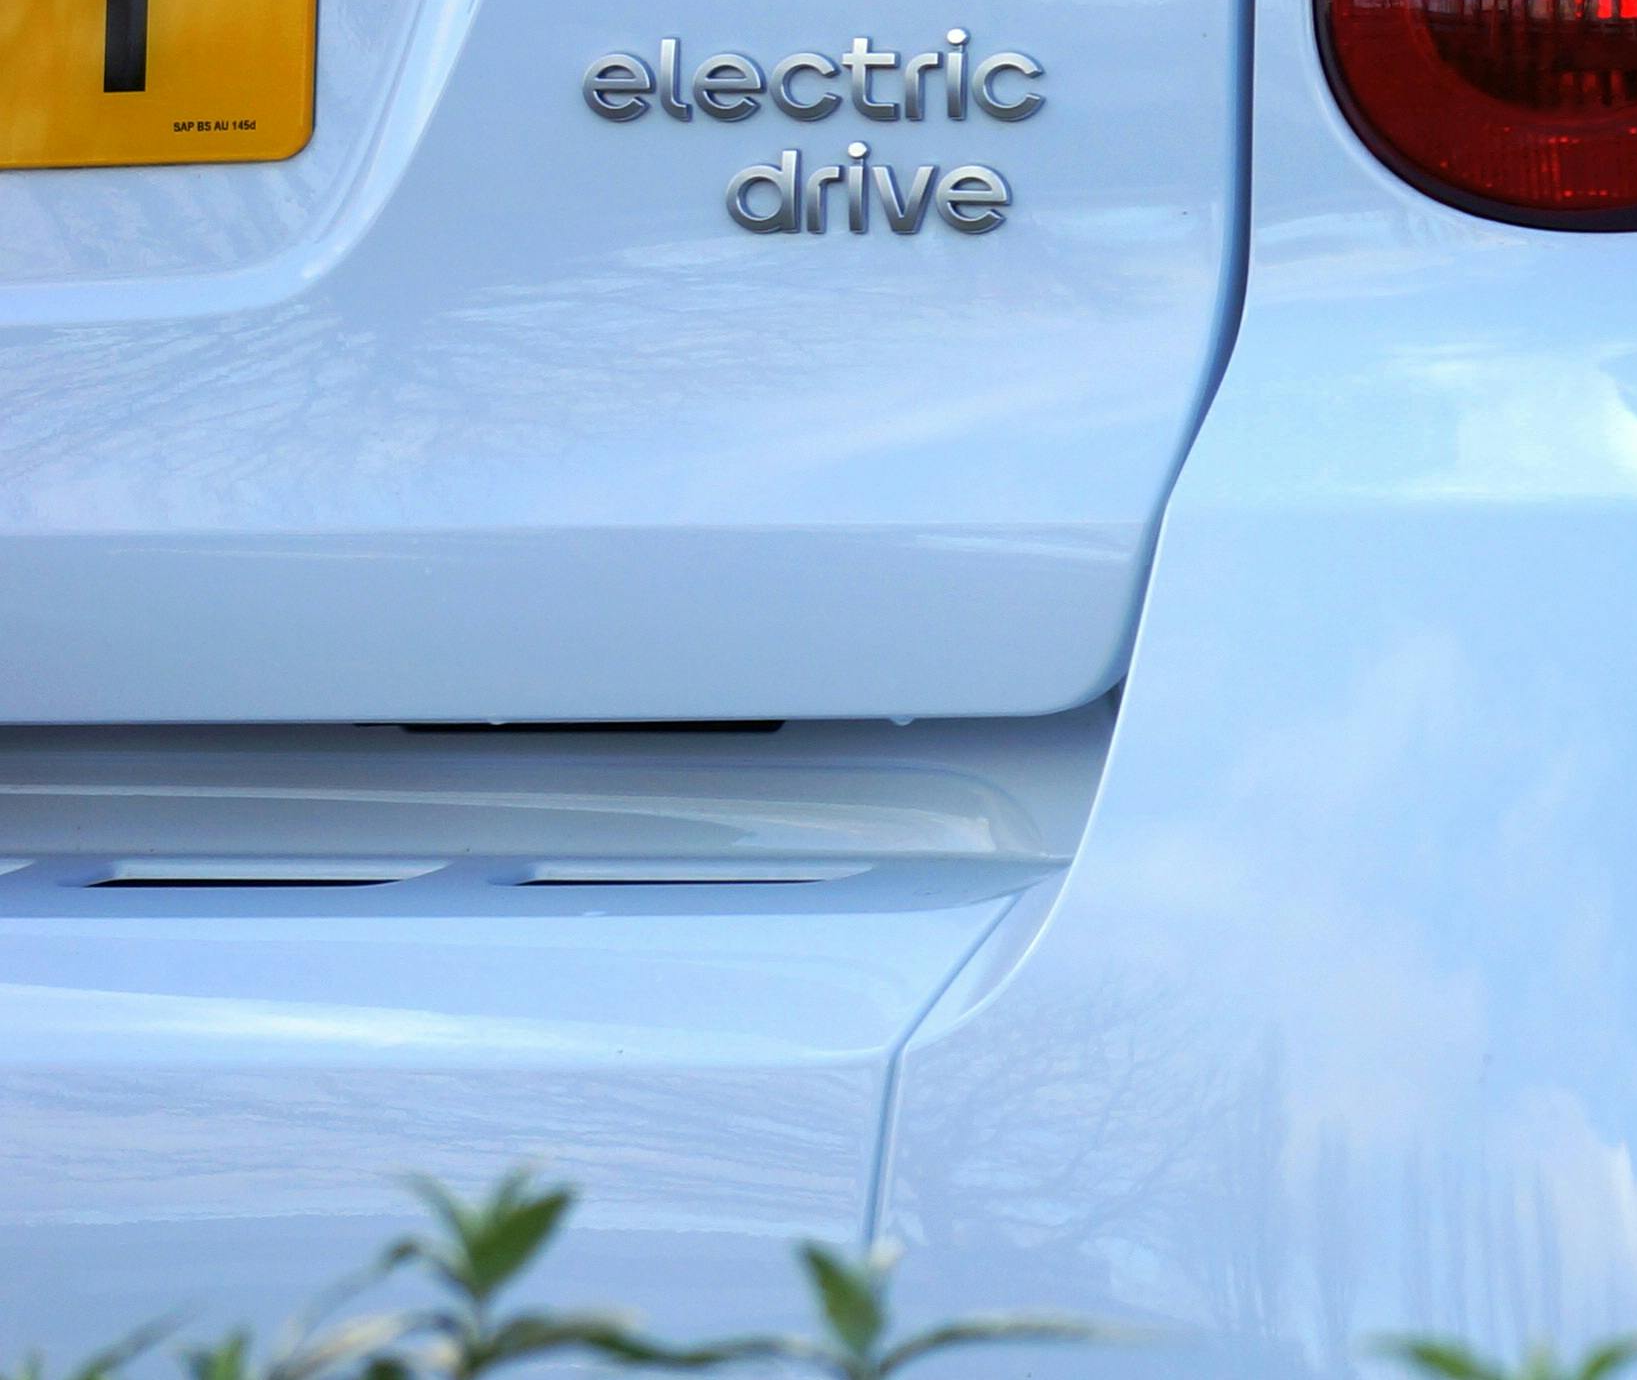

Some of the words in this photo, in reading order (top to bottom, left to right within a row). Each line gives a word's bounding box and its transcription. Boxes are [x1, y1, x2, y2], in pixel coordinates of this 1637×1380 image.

[582, 27, 1046, 122] electric
[174, 121, 194, 132] SAP
[197, 121, 211, 132] BS
[214, 120, 229, 131] AU
[232, 119, 257, 131] 145d
[725, 140, 1013, 235] drive
